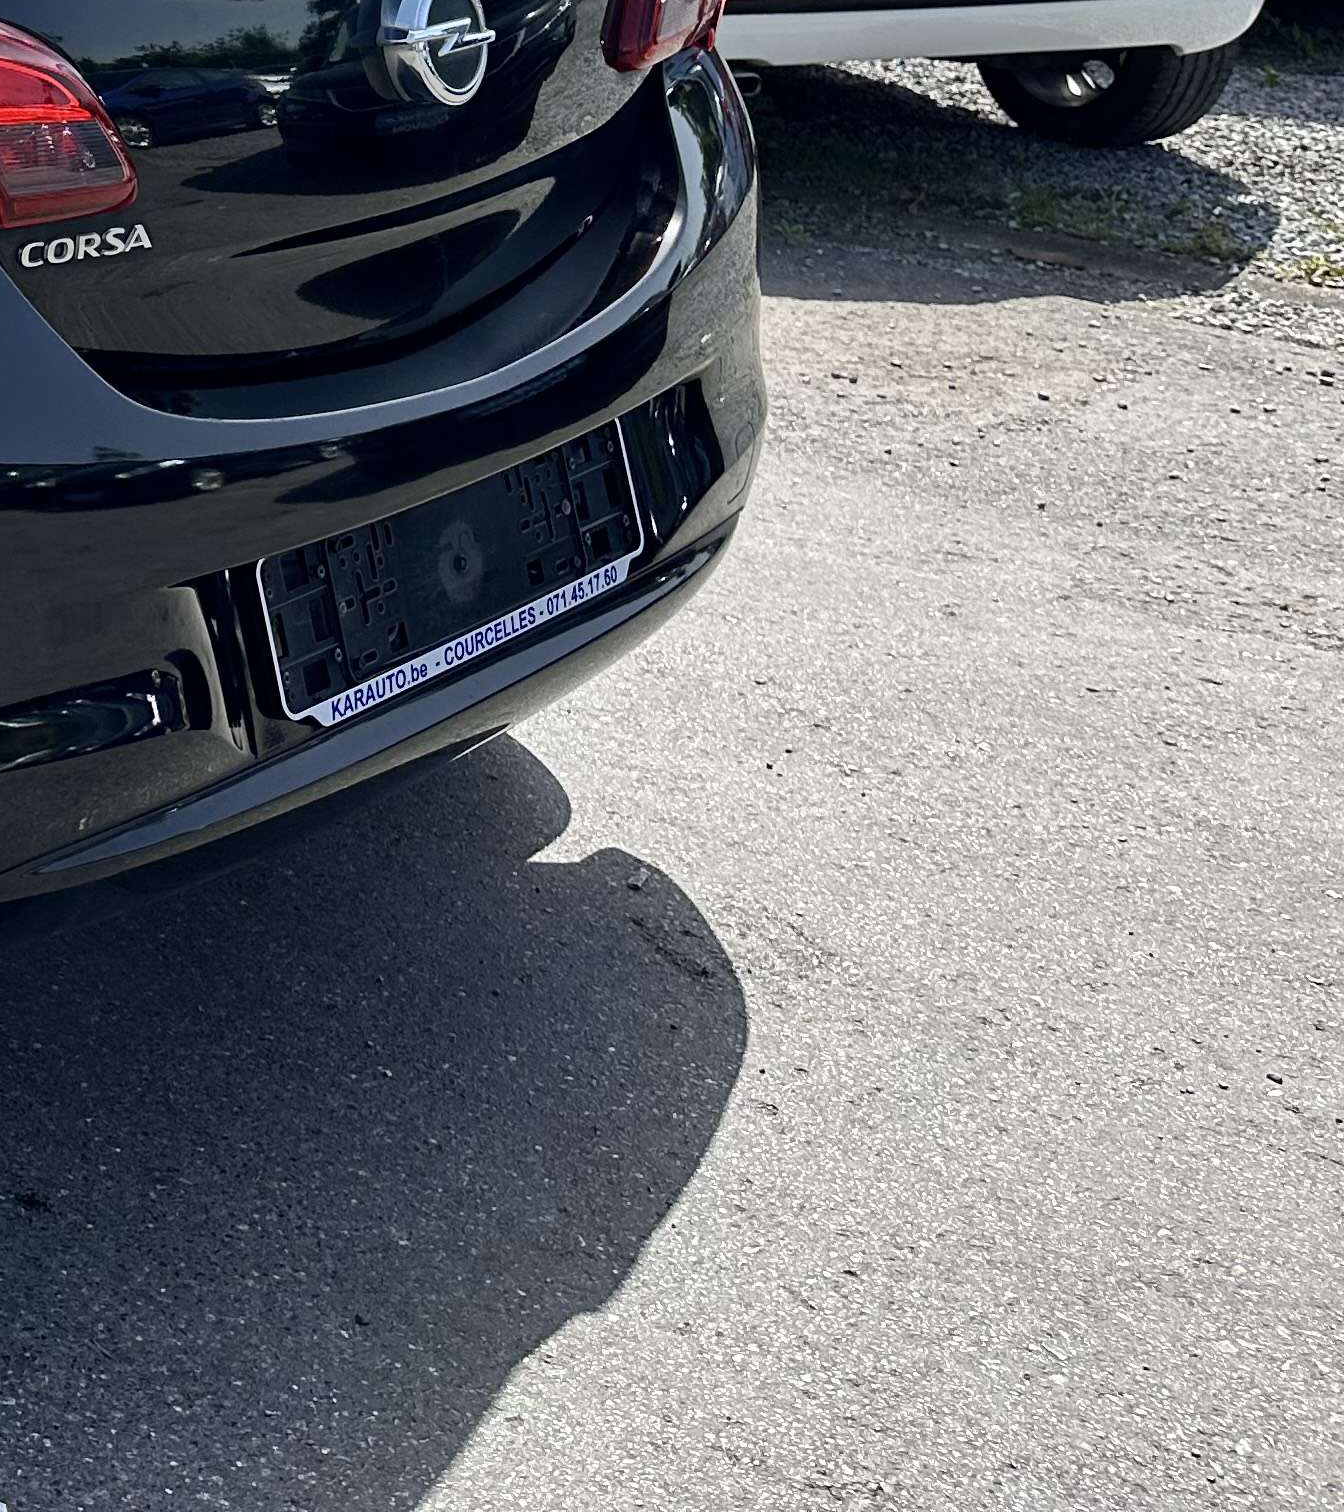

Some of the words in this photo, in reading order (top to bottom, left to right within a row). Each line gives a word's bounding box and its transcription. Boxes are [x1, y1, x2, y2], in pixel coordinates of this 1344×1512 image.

[20, 224, 153, 268] CORSA
[330, 663, 428, 722] KARAUTO.be
[443, 606, 537, 667] COURCELLES
[546, 567, 618, 617] 071.45.17.60
